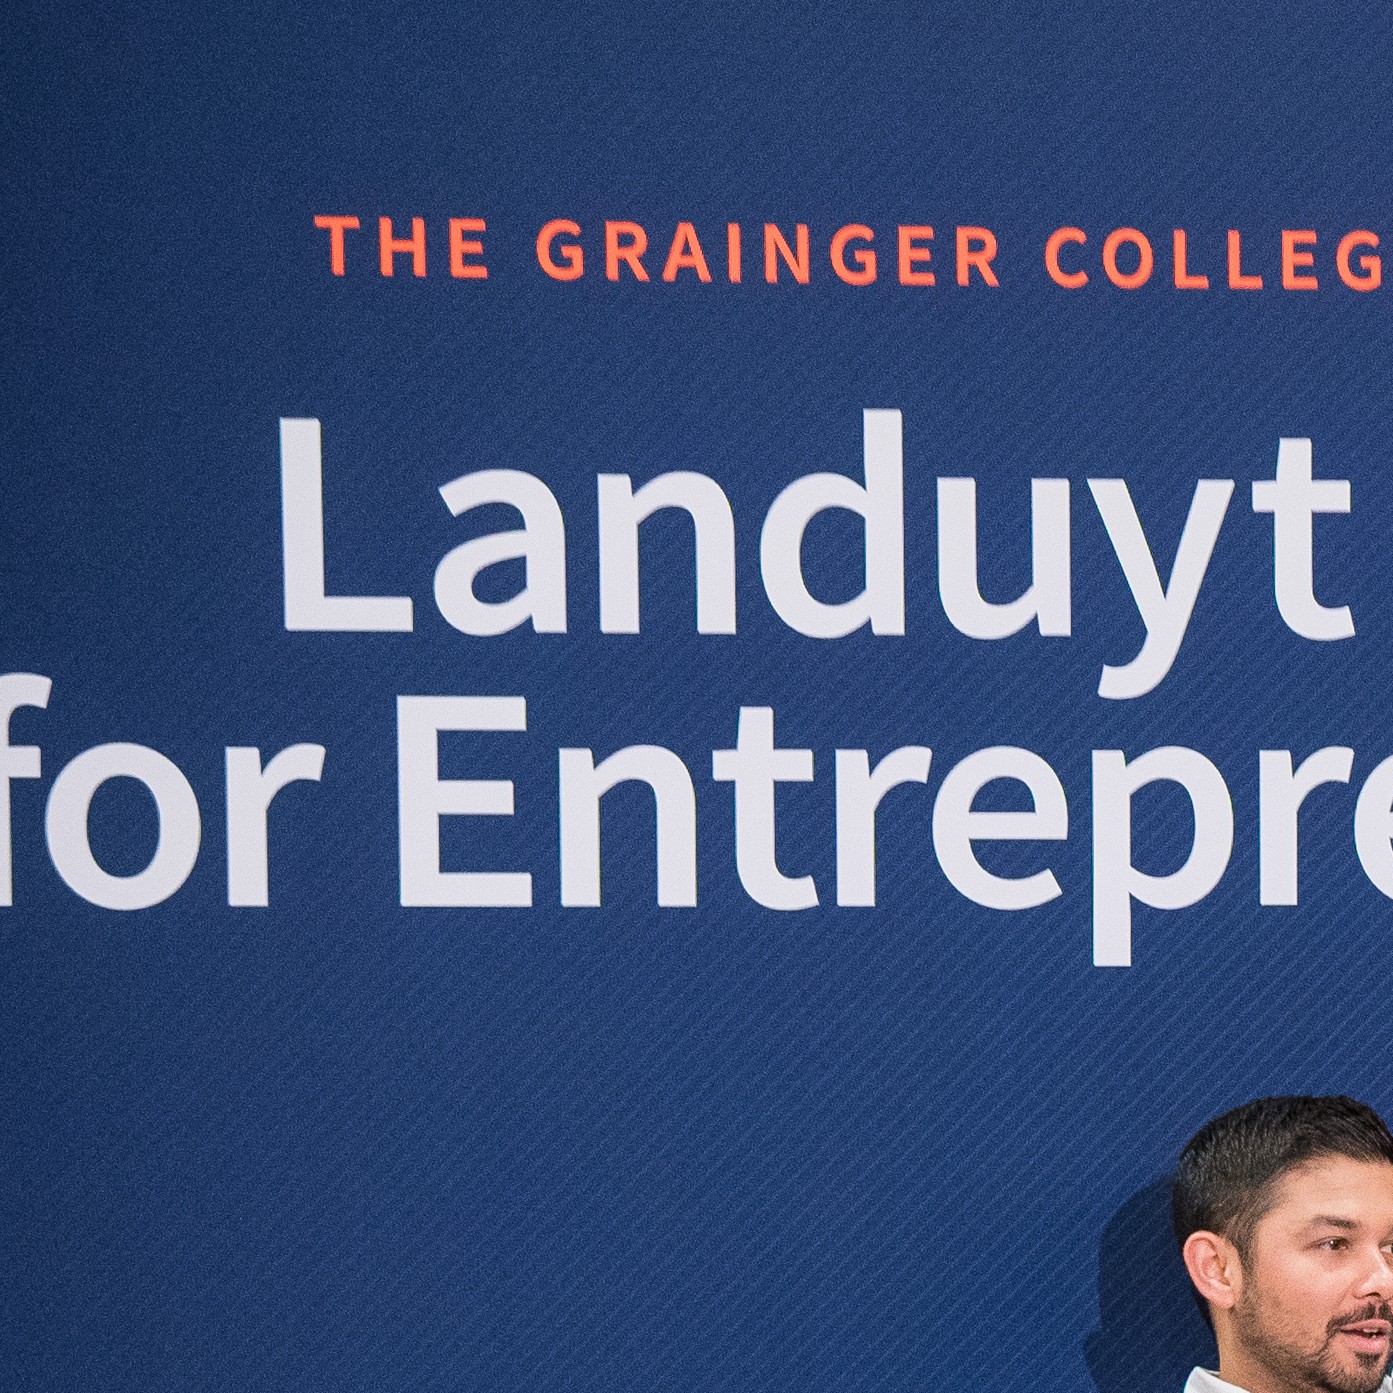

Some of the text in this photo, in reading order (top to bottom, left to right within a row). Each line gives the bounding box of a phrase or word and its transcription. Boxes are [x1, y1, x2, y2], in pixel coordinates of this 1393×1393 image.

[313, 214, 489, 280] THE
[535, 217, 999, 288] GRAINGER
[280, 408, 1355, 701] Landuyt
